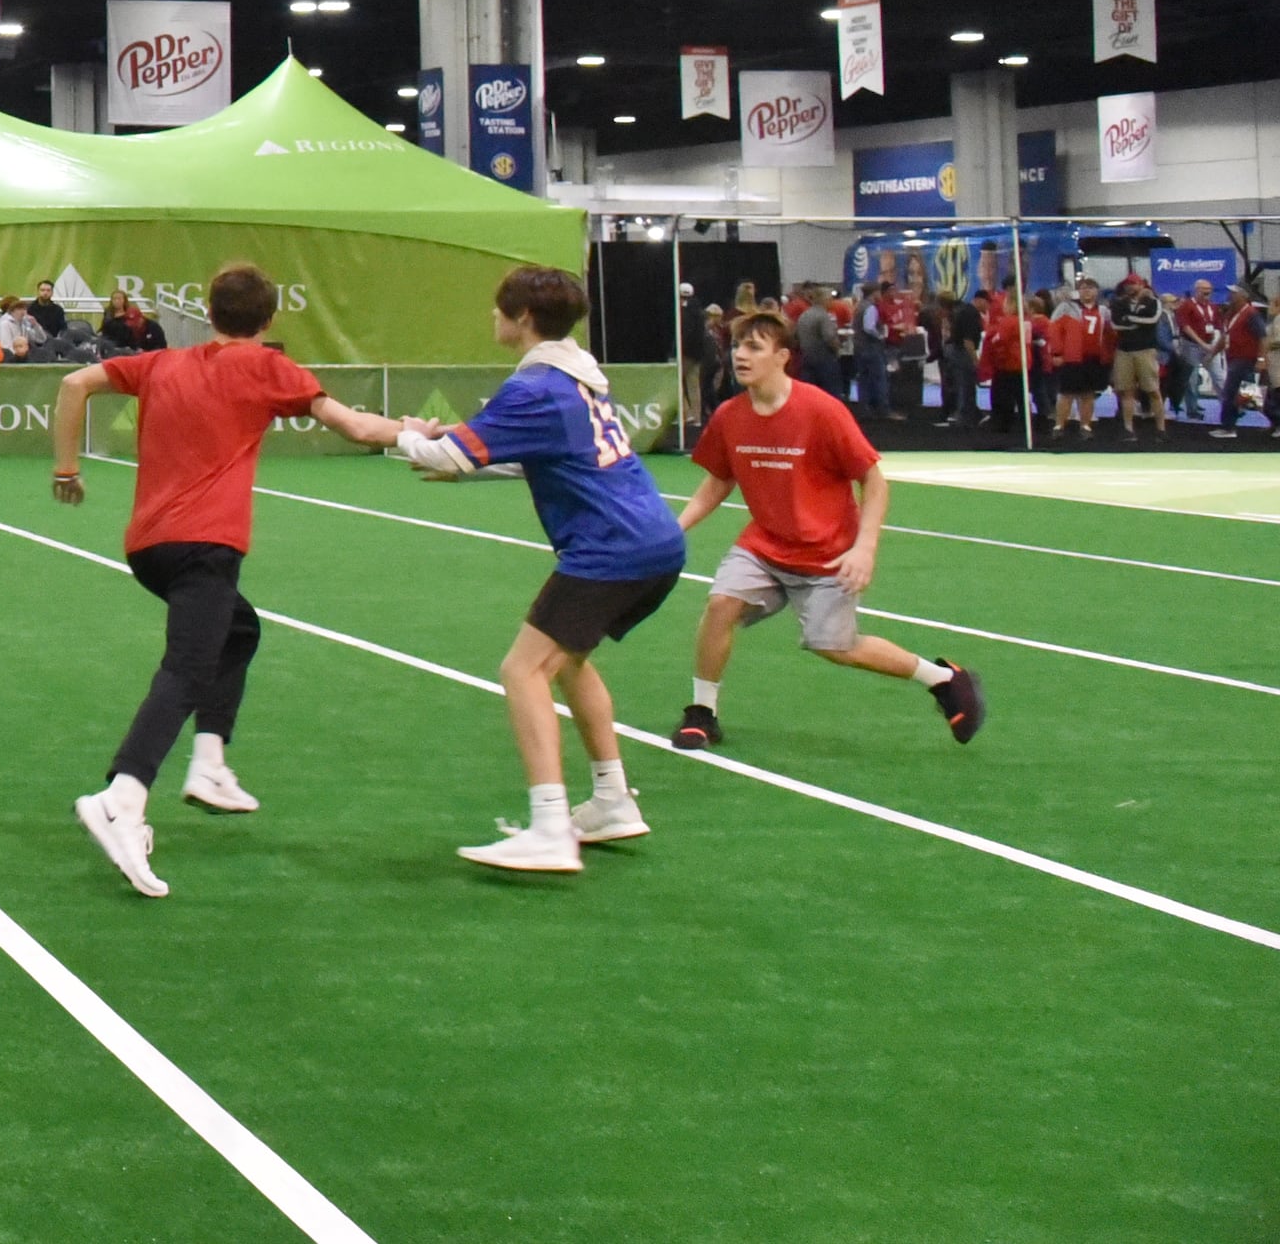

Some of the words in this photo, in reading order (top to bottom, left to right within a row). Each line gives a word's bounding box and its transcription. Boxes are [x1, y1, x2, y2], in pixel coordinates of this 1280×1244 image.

[1111, 10, 1138, 22] GIFT
[154, 34, 190, 63] Dr
[117, 40, 214, 90] Pepper
[493, 79, 512, 92] Dr
[475, 83, 521, 109] Pepper
[771, 96, 802, 118] Dr
[479, 118, 516, 126] TASTING
[487, 126, 525, 135] STATION
[747, 102, 820, 140] Pepper
[1121, 118, 1136, 136] Dr
[295, 139, 405, 153] REGIONS
[1104, 124, 1148, 157] Pepper
[859, 176, 936, 195] SOUTHEASTERN
[114, 275, 307, 312] REGS
[1083, 315, 1097, 334] 7
